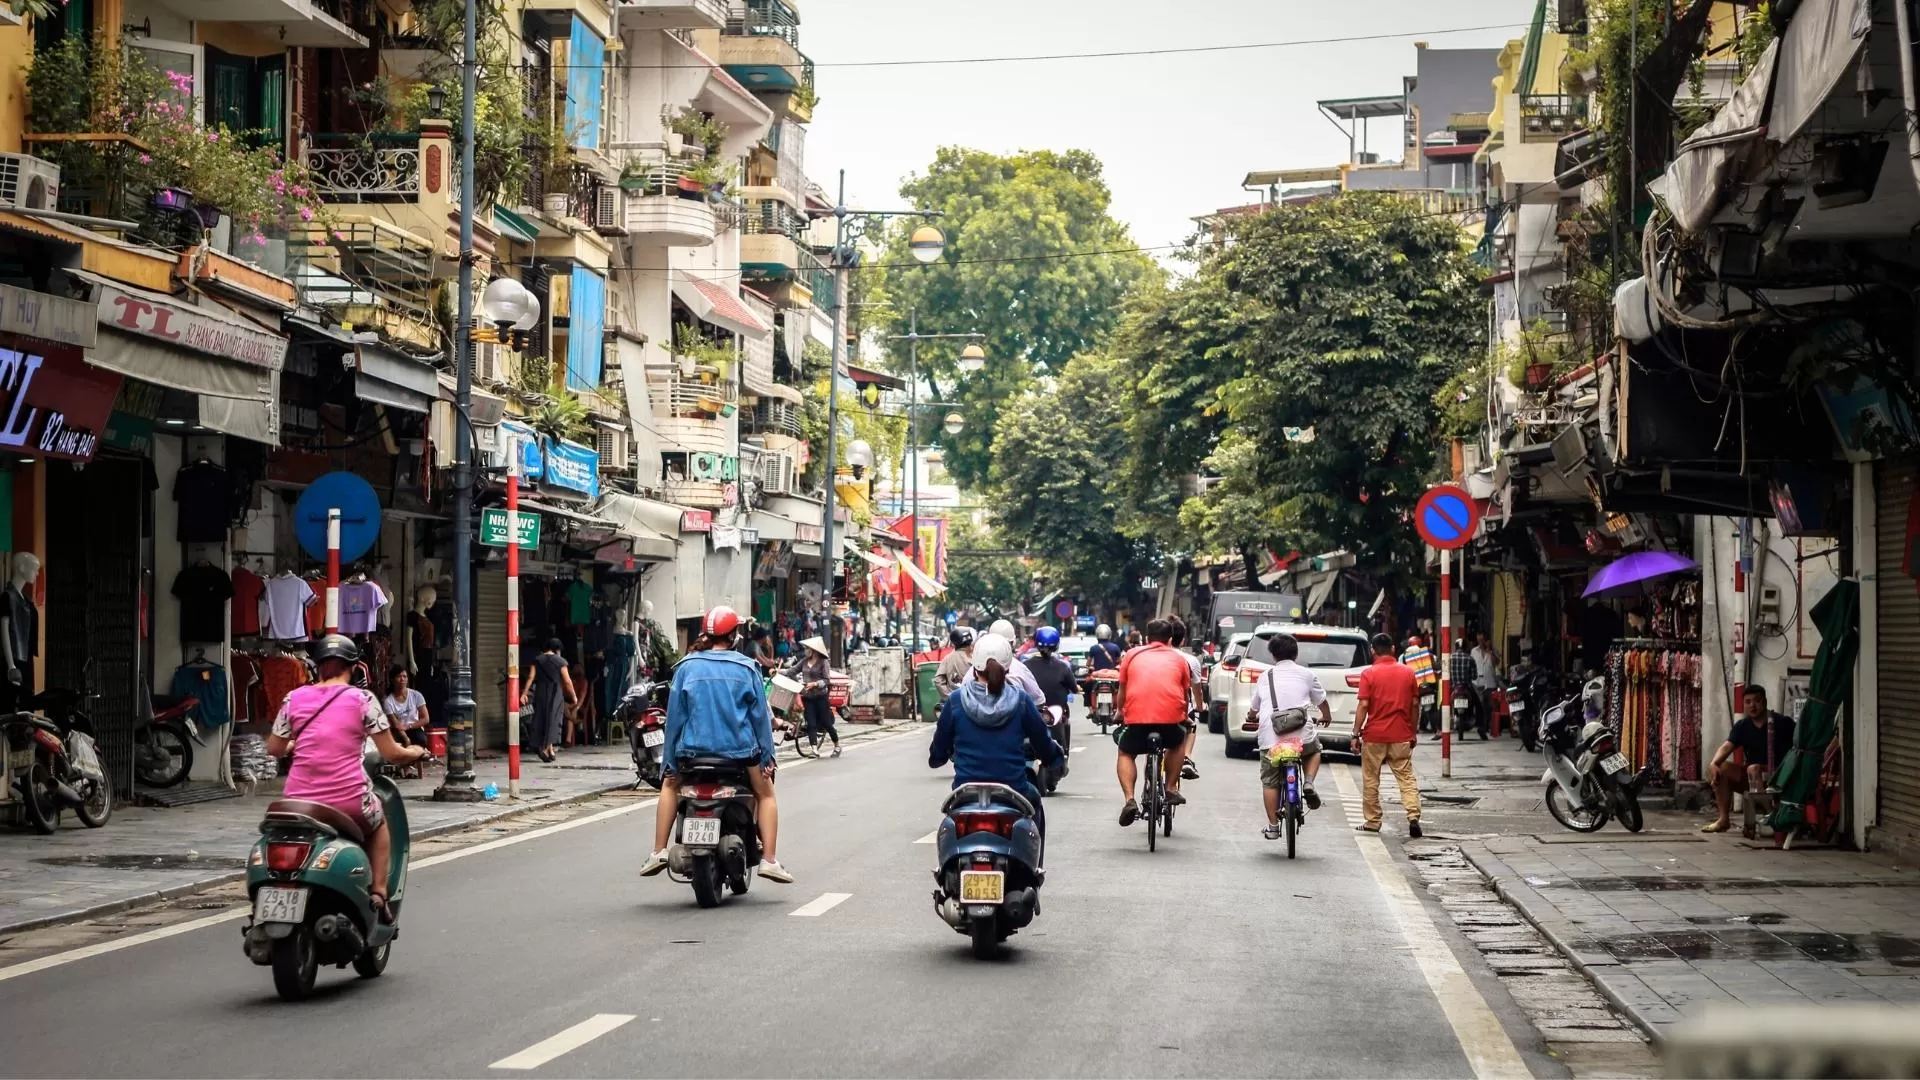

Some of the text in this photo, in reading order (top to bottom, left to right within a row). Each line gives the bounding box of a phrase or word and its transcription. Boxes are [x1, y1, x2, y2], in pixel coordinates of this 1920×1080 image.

[114, 295, 181, 340] TL
[39, 411, 64, 451] 82
[515, 517, 535, 529] WC
[491, 527, 531, 536] TOET
[688, 832, 714, 843] 8240
[262, 905, 297, 920] 6431
